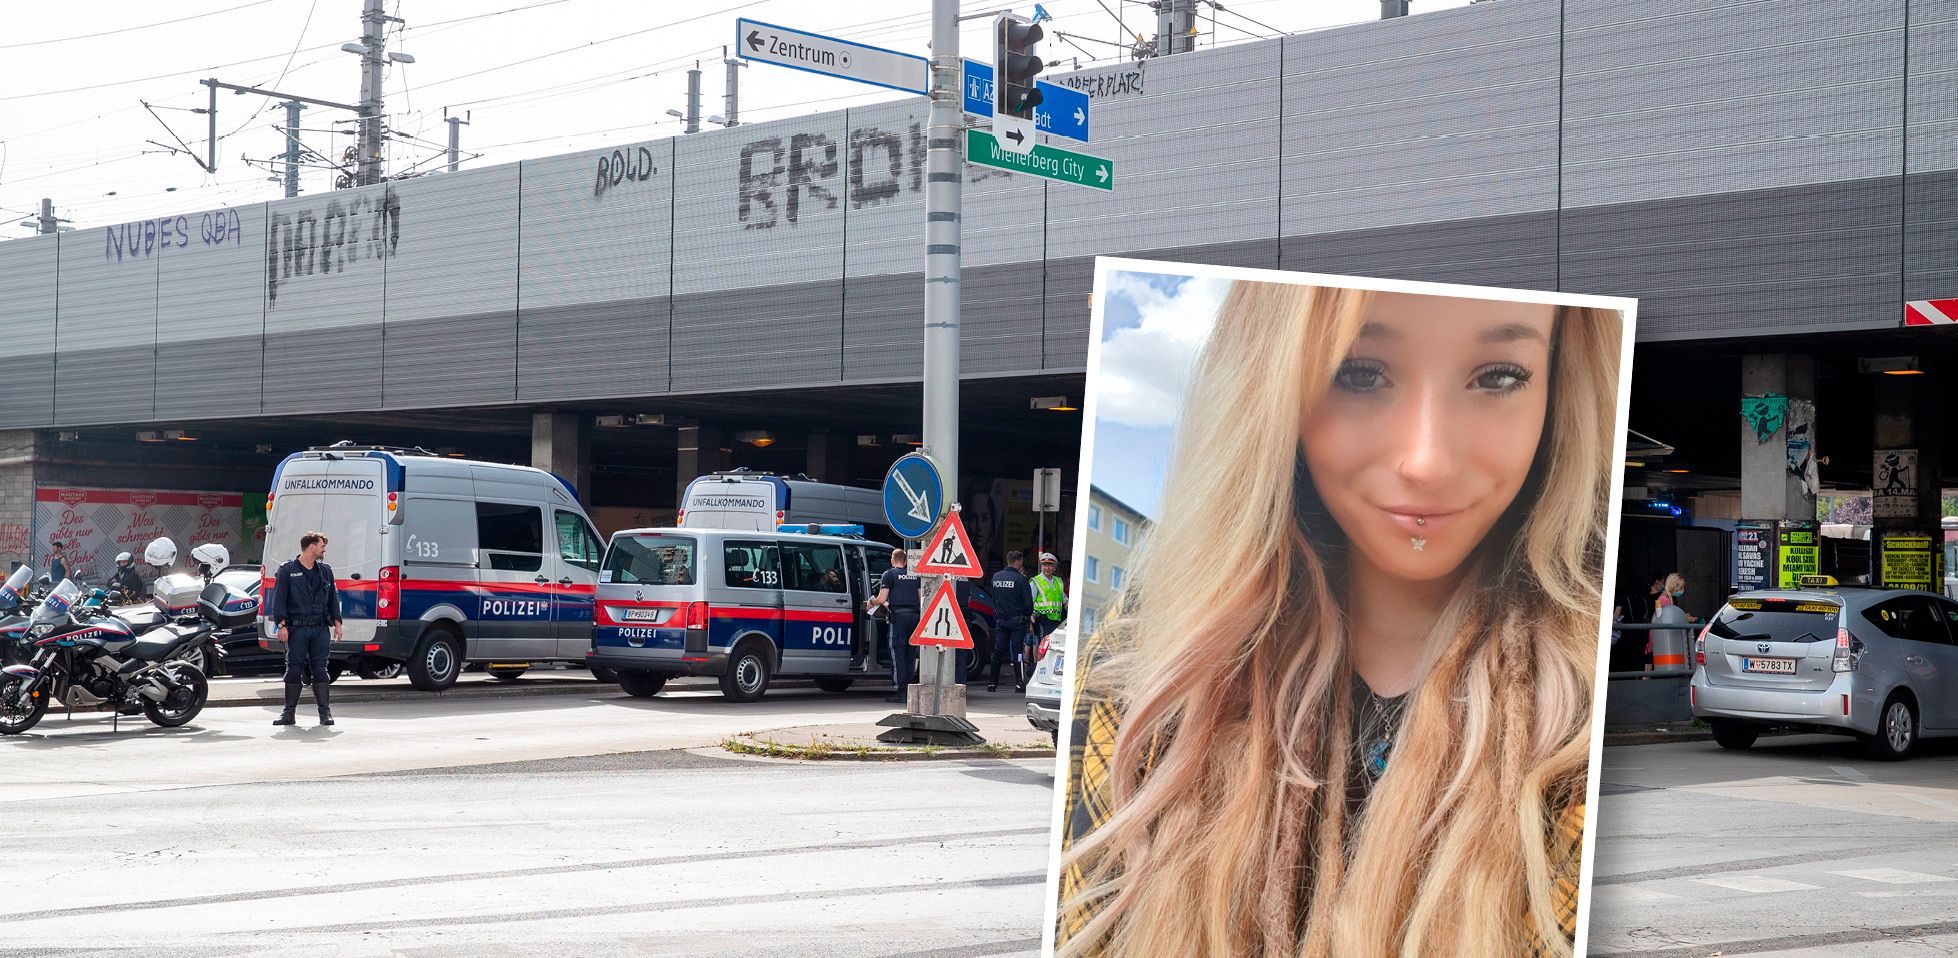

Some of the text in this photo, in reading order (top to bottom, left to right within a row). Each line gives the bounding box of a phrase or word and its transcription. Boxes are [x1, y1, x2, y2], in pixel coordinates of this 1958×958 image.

[769, 35, 835, 66] Zentrum
[1035, 112, 1051, 129] adt
[990, 141, 1085, 181] Wienerberg City
[284, 479, 375, 490] UNFALLKOMMANDO
[692, 497, 765, 509] UNFALLKOMMANDO
[50, 525, 94, 544] gibts nur
[116, 527, 164, 544] schmeckt
[212, 530, 229, 540] nur
[416, 541, 439, 558] 133
[760, 570, 778, 585] 133
[993, 580, 1014, 588] POLIZEI
[482, 600, 540, 617] POLIZEI
[66, 630, 102, 641] POLIZEI
[618, 627, 657, 638] POLIZEI
[812, 627, 851, 645] POLI
